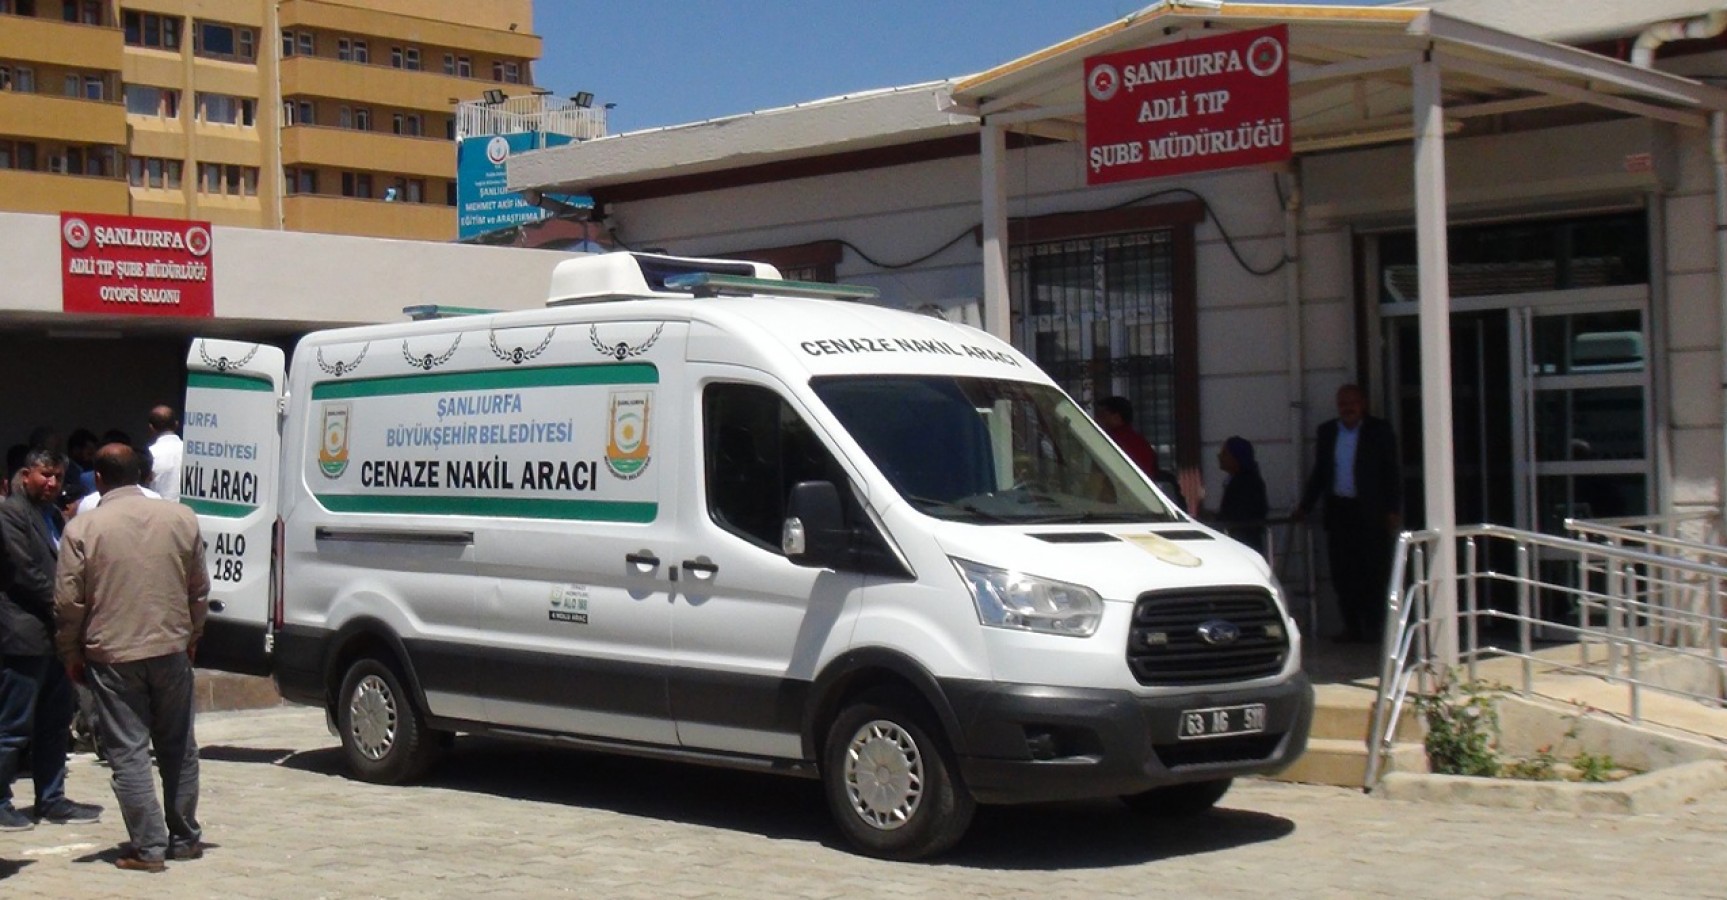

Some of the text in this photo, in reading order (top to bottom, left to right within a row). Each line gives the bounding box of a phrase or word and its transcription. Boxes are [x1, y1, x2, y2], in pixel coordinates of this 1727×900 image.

[1123, 49, 1244, 92] ŞANLIURFA
[1137, 90, 1230, 123] ADLİ TIP
[1090, 118, 1285, 173] ŞUBE MÜDÜRLÜĞÜ
[465, 201, 497, 211] MEHMET
[461, 213, 486, 226] EĞİTİM
[94, 226, 184, 248] ŞANLIURFA
[69, 258, 207, 281] ADLİ TIP ŞUBE MÜDÜRLÜĞÜ
[100, 284, 180, 304] OTOPSİ SALONU
[800, 337, 1022, 368] CENAZE NAKİL ARACI
[436, 393, 522, 422] ŞANLIURFA
[386, 418, 573, 451] BÜYÜKŞEHİR BELEDİYESİ
[186, 439, 257, 461] BELEDİYESİ
[361, 459, 440, 488] CENAZE
[446, 454, 514, 490] NAKİL
[520, 460, 598, 491] ARACI
[209, 468, 259, 504] ARACI
[215, 532, 246, 558] ALO
[213, 556, 244, 583] 188
[564, 598, 577, 609] ALO
[1186, 712, 1205, 735] 63
